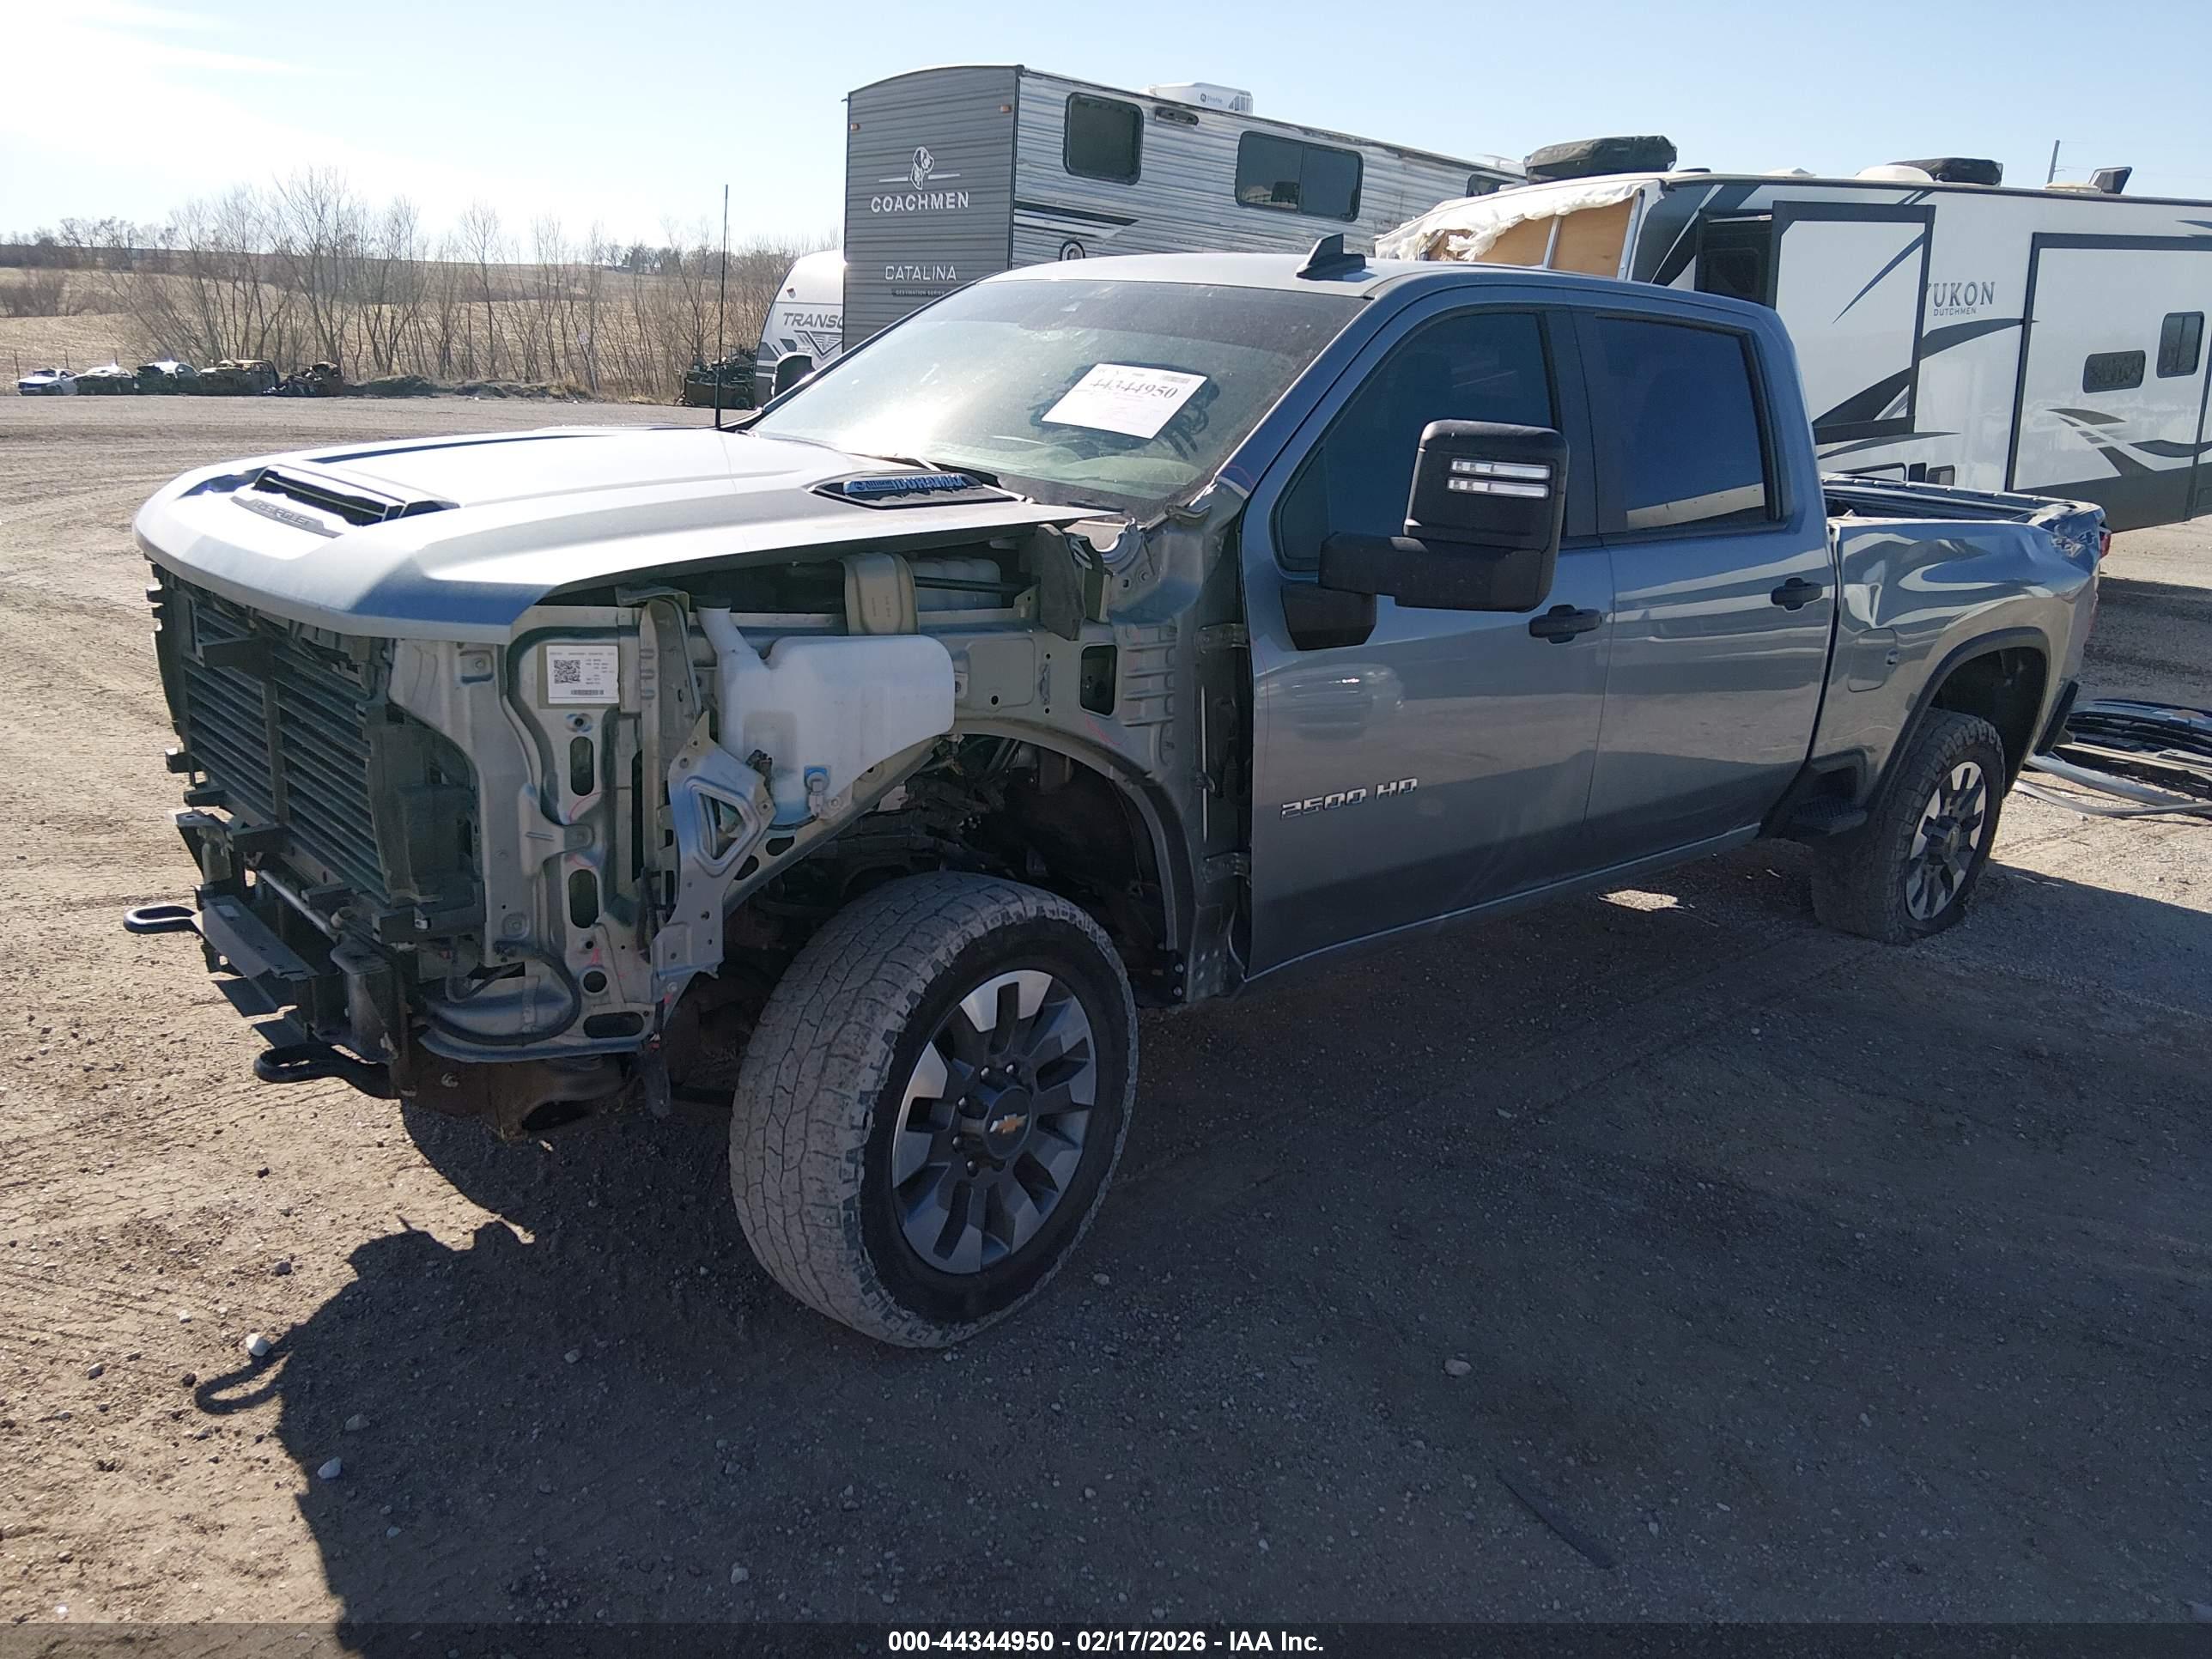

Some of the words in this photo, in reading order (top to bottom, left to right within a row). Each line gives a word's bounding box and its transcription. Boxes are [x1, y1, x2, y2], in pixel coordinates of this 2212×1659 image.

[871, 191, 969, 213] COACHMEN
[884, 265, 957, 281] CATALINA
[1933, 307, 1977, 316] DUTCHMEN
[1281, 787, 1367, 820] 2500
[1376, 777, 1419, 799] HD
